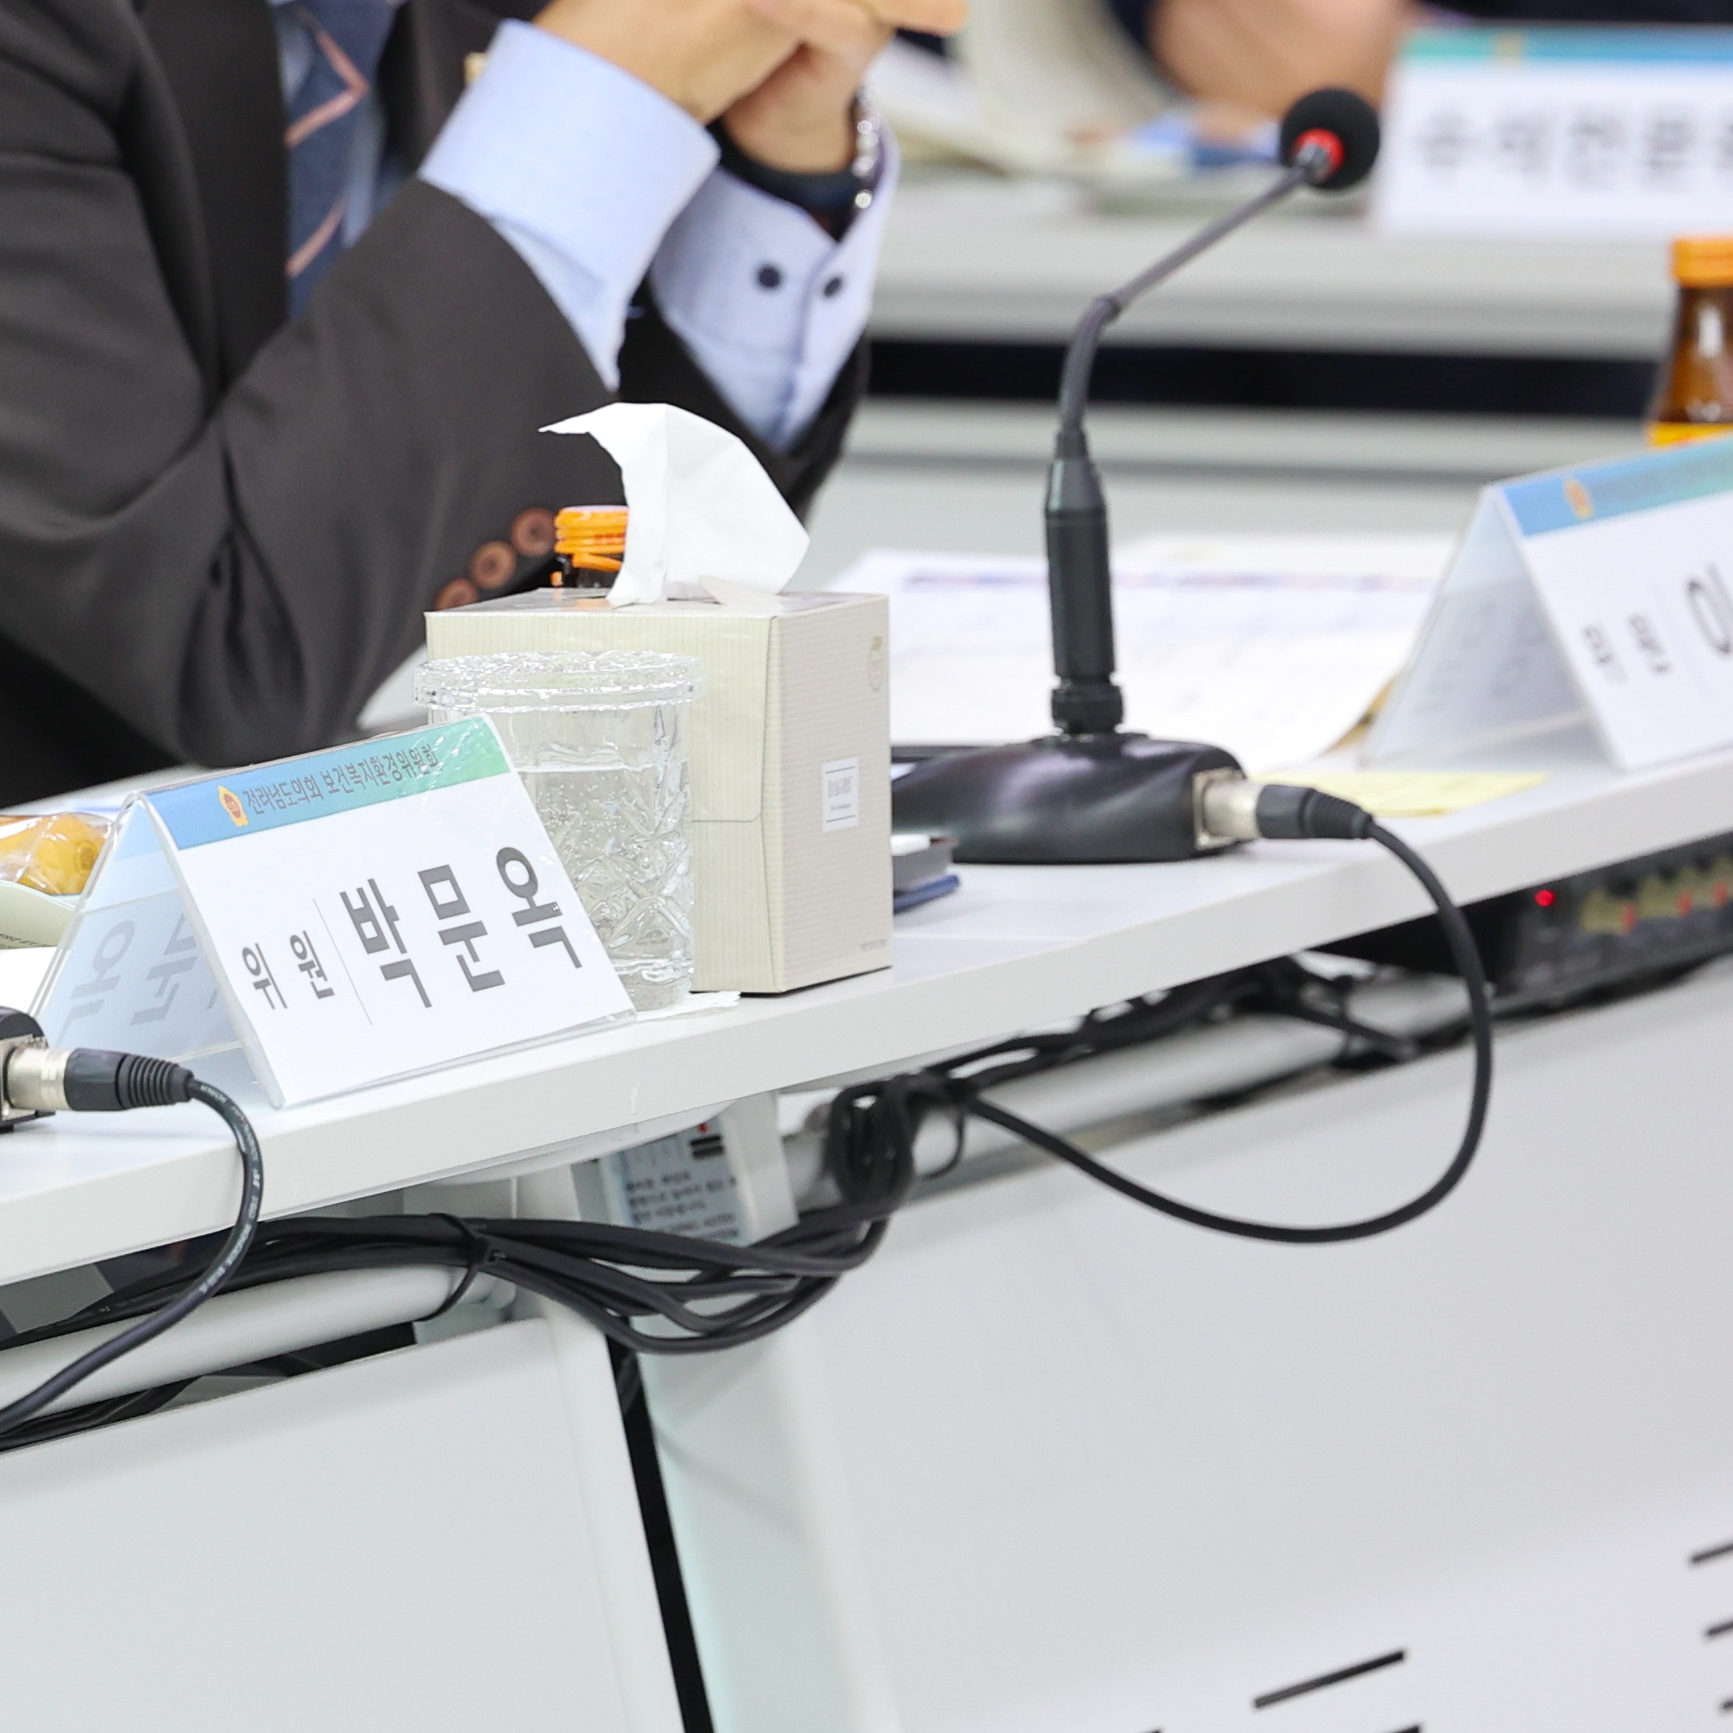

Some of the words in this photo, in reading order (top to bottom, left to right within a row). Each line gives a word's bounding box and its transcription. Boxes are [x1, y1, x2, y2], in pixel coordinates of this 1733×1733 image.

[242, 774, 325, 815] 전라남도의회
[241, 929, 336, 1010] 위원
[339, 846, 583, 1008] 박문옥
